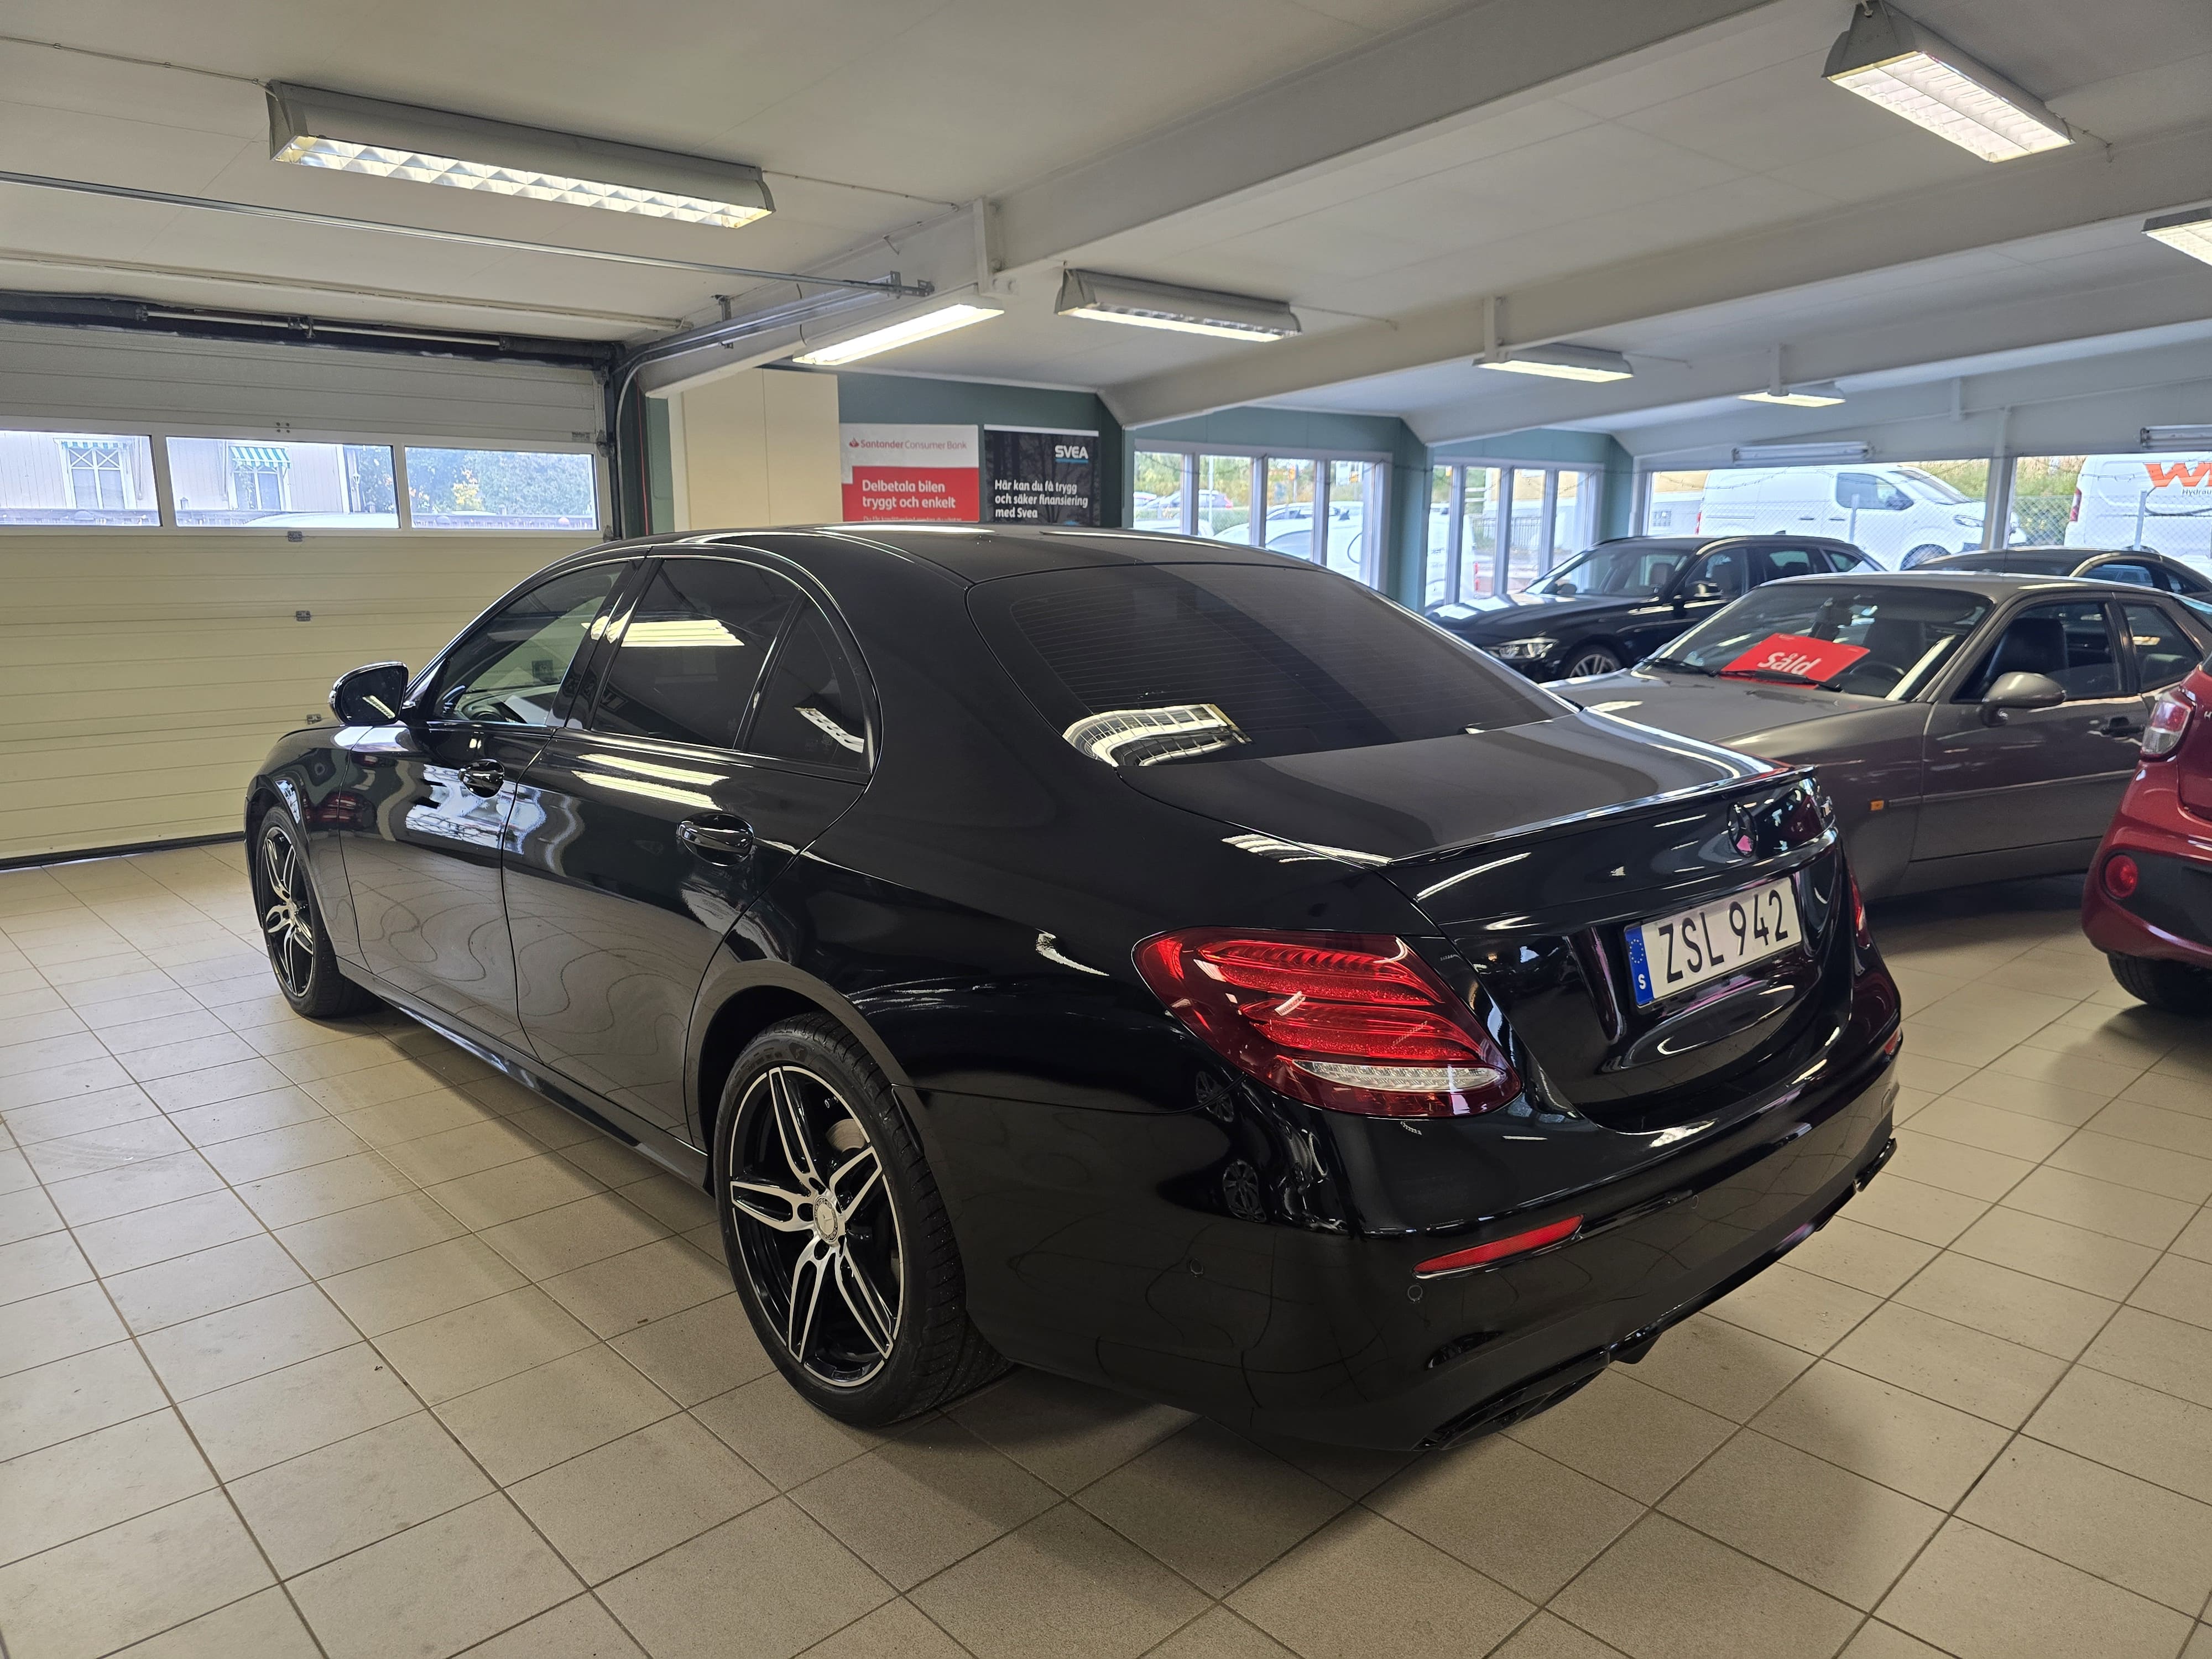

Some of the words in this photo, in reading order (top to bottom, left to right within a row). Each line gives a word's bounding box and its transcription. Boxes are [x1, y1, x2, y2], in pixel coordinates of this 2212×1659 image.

[860, 440, 903, 448] Santander
[905, 440, 945, 450] Consumer
[947, 441, 967, 450] Bank
[1055, 445, 1088, 459] SVEA
[2142, 461, 2212, 487] W
[862, 479, 916, 492] Delbetala
[919, 480, 945, 493] bilen
[995, 479, 1011, 491] Här
[1014, 479, 1030, 491] kan
[1031, 480, 1043, 492] du
[1045, 480, 1053, 492] få
[1056, 482, 1077, 494] trygg
[862, 496, 897, 510] tryggt
[899, 496, 920, 508] och
[922, 496, 956, 509] enkelt
[995, 493, 1011, 504] och
[1014, 493, 1037, 505] säker
[1039, 493, 1088, 508] finansiering
[995, 507, 1015, 518] med
[1017, 508, 1037, 518] Svea
[1757, 652, 1822, 675] Såld
[1658, 912, 1724, 983] ZSL
[1728, 890, 1788, 956] 942
[1638, 974, 1646, 990] S
